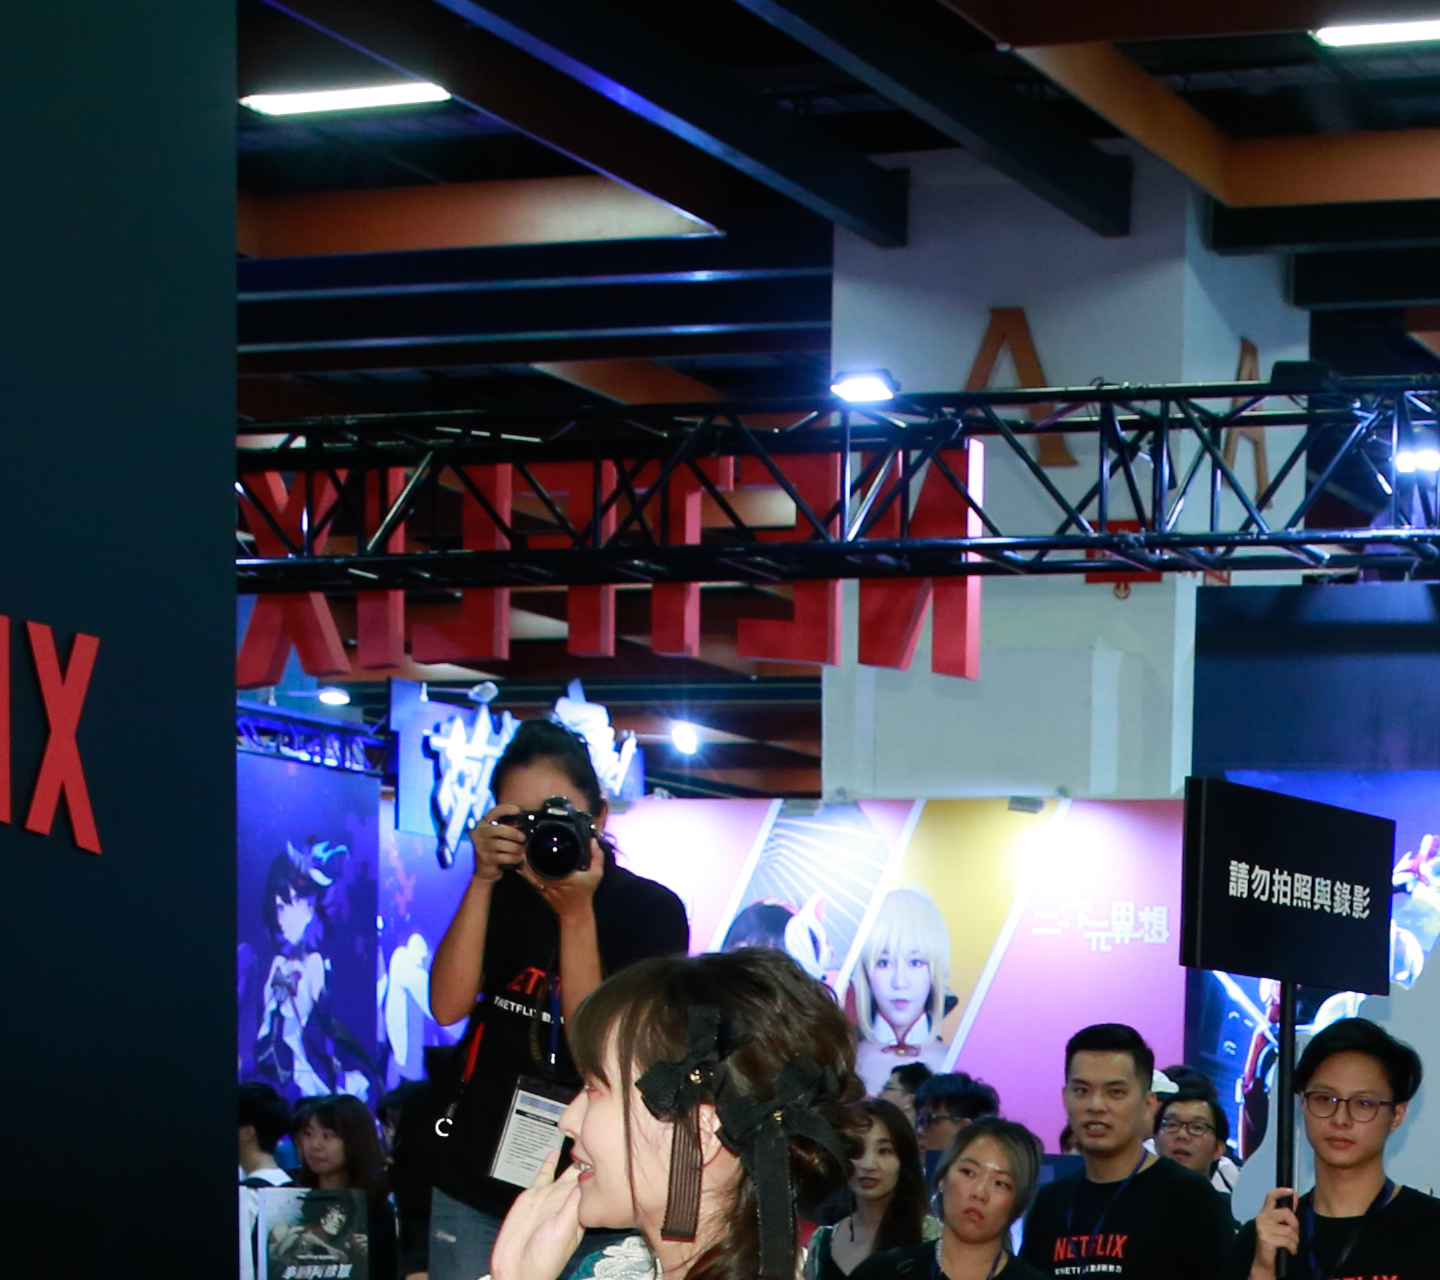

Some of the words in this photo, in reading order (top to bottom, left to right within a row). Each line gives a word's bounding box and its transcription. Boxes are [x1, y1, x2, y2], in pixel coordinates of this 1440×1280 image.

[1227, 860, 1372, 920] 請勿拍照與錄影
